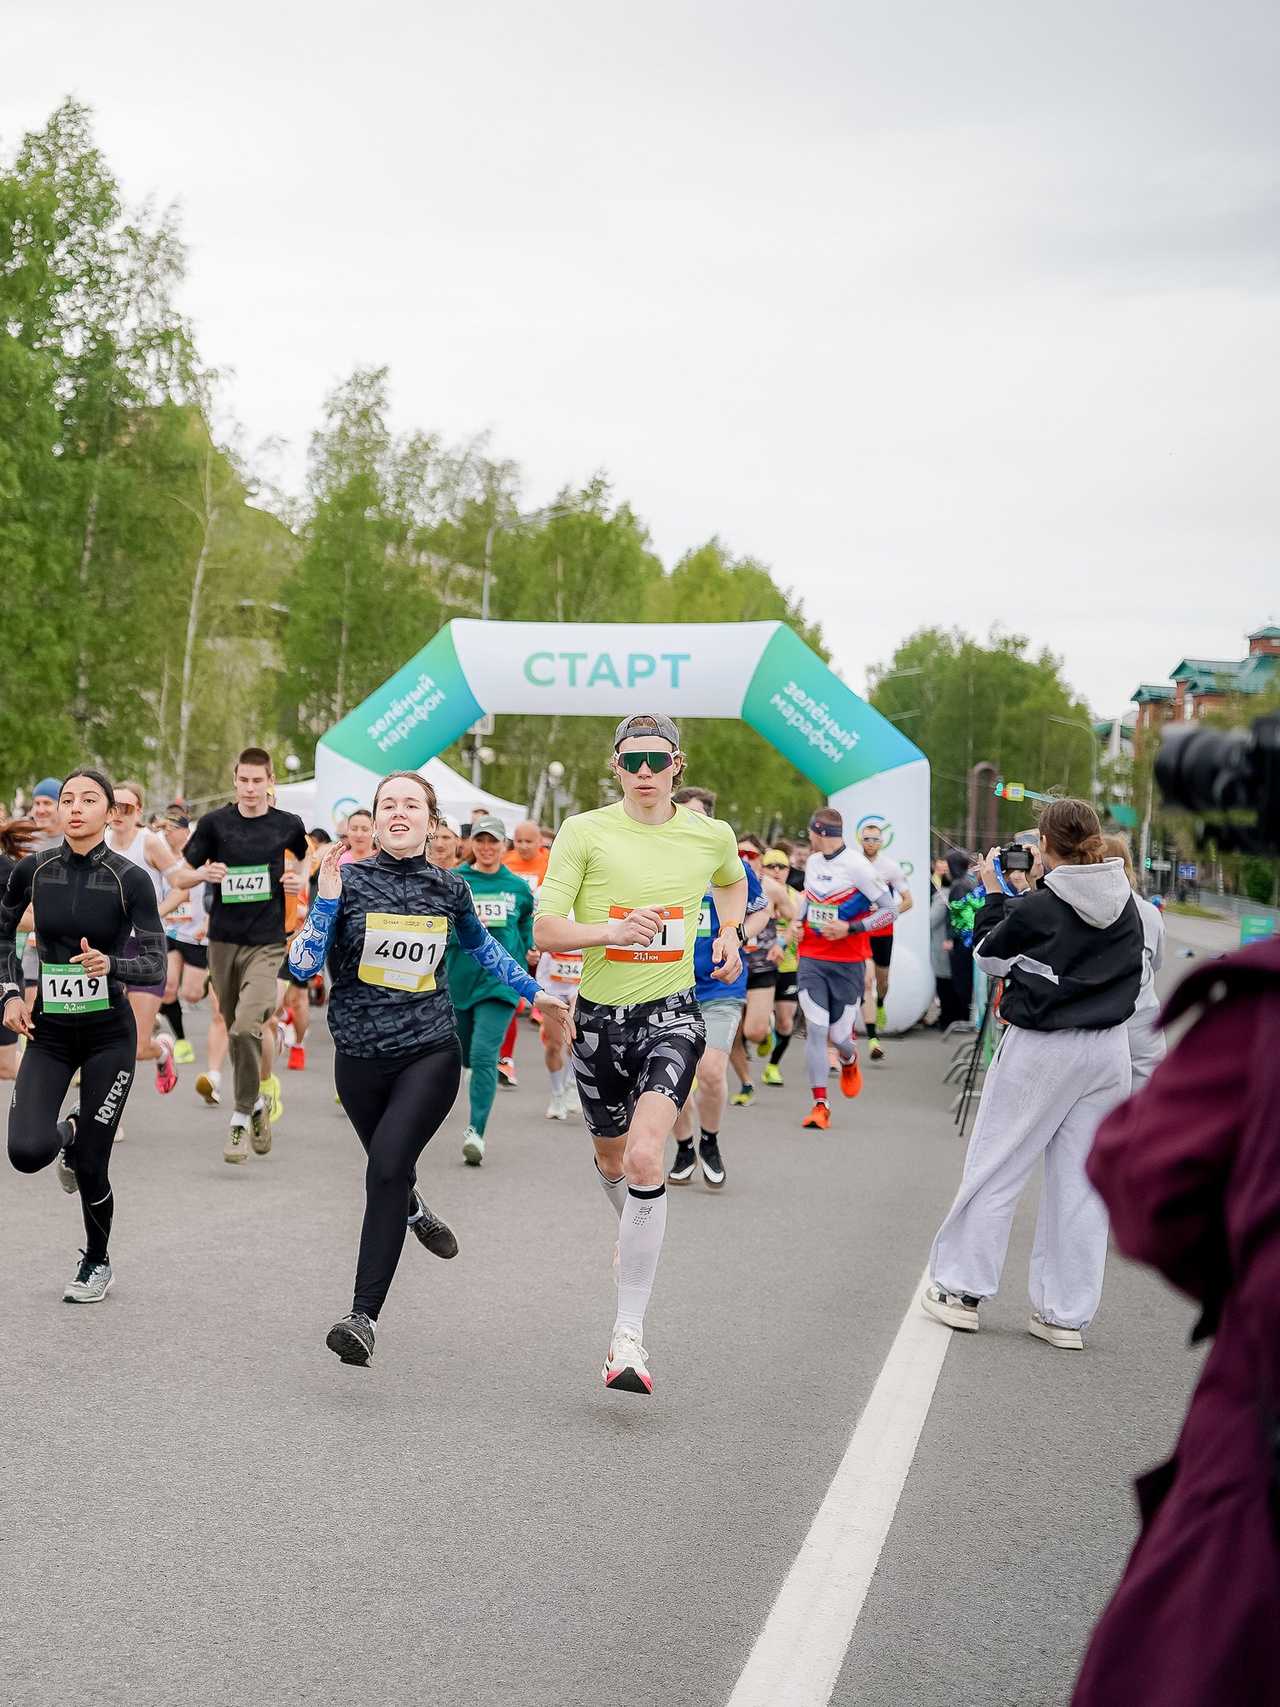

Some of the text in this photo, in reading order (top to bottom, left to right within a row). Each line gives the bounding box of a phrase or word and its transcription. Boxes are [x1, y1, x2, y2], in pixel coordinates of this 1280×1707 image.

[523, 651, 691, 689] СТАРТ
[366, 673, 436, 740] зелёный
[377, 688, 447, 752] марафон
[769, 692, 844, 764] марафон
[782, 680, 860, 751] зелёный
[226, 876, 264, 892] 1447
[374, 939, 437, 965] 4001
[48, 978, 100, 998] 1419
